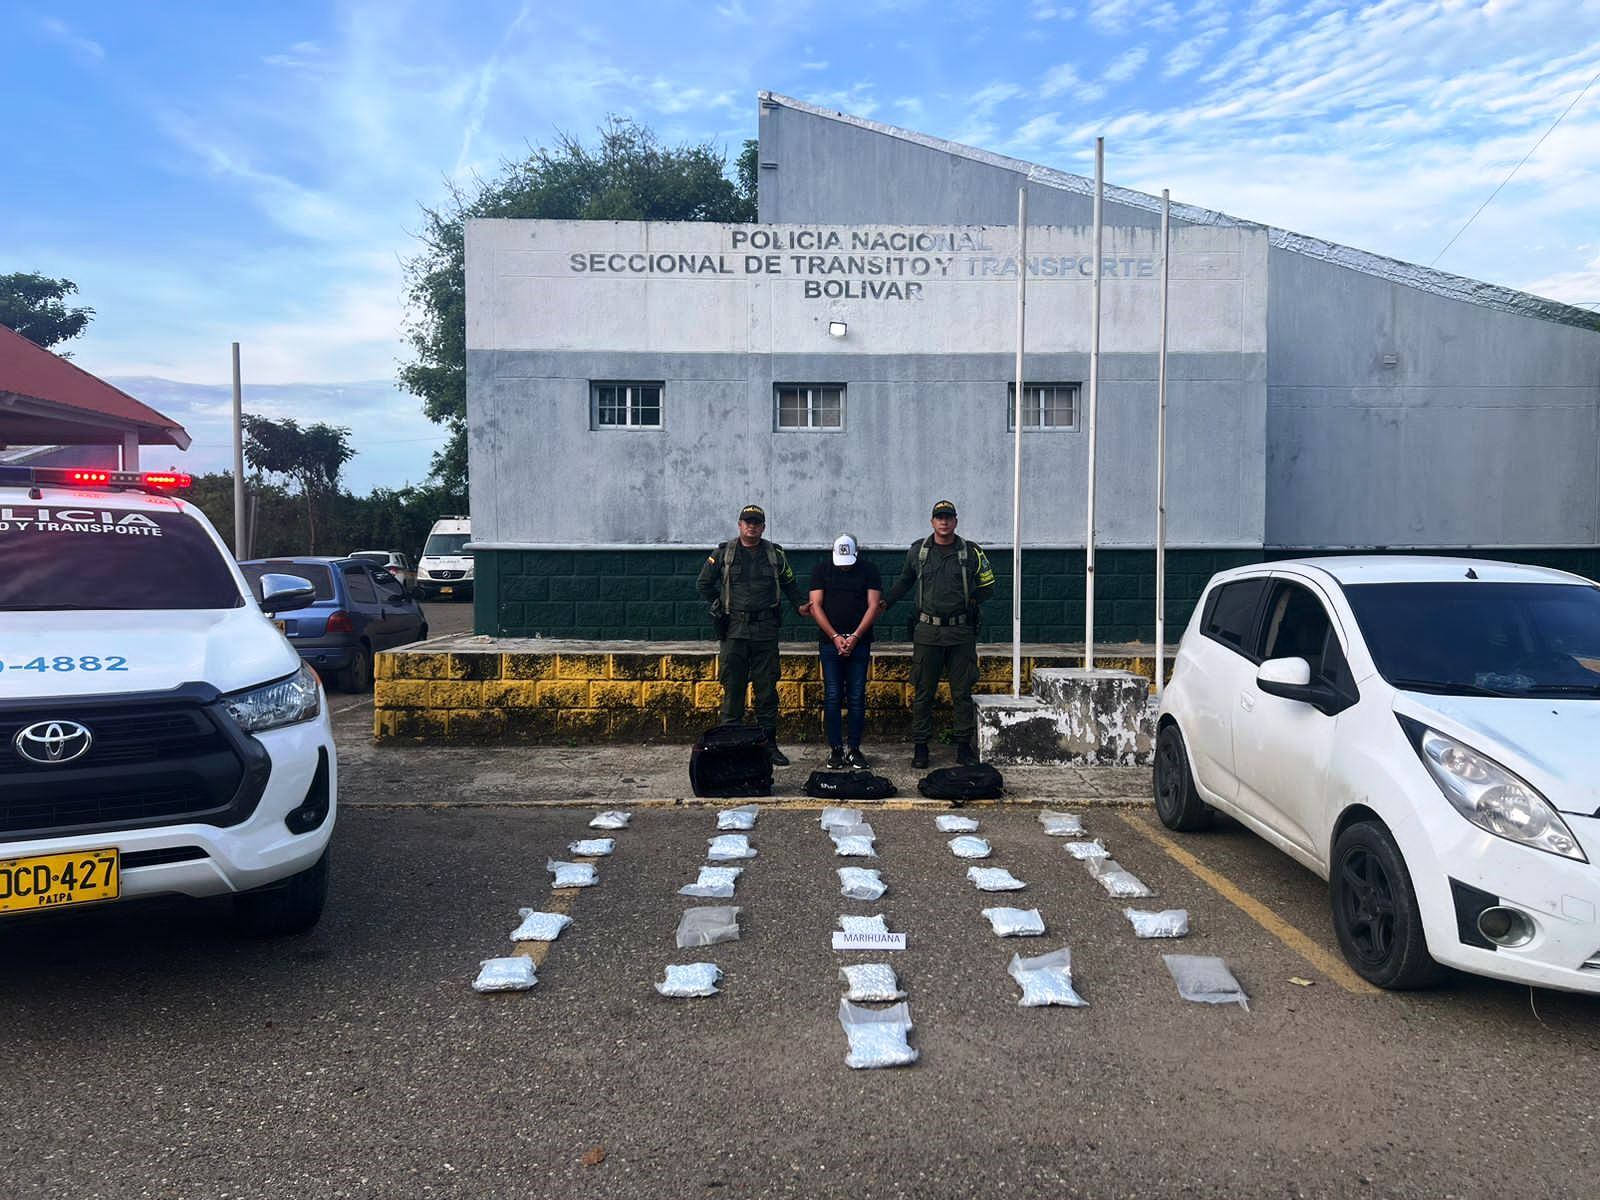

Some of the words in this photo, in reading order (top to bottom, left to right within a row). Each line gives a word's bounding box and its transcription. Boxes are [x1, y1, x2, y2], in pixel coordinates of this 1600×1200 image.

[731, 230, 842, 250] POLICIA
[851, 231, 993, 252] NACIONAL
[570, 253, 735, 274] SECCIONAL
[744, 255, 782, 274] DE
[963, 255, 1153, 277] TRANSPORTE
[804, 279, 923, 300] BOLIVAR
[16, 522, 29, 531] Y
[34, 522, 163, 537] TRANSPORTE
[0, 656, 128, 672] -4882
[38, 893, 73, 905] PAIPA
[844, 934, 901, 943] MARIHUANA
